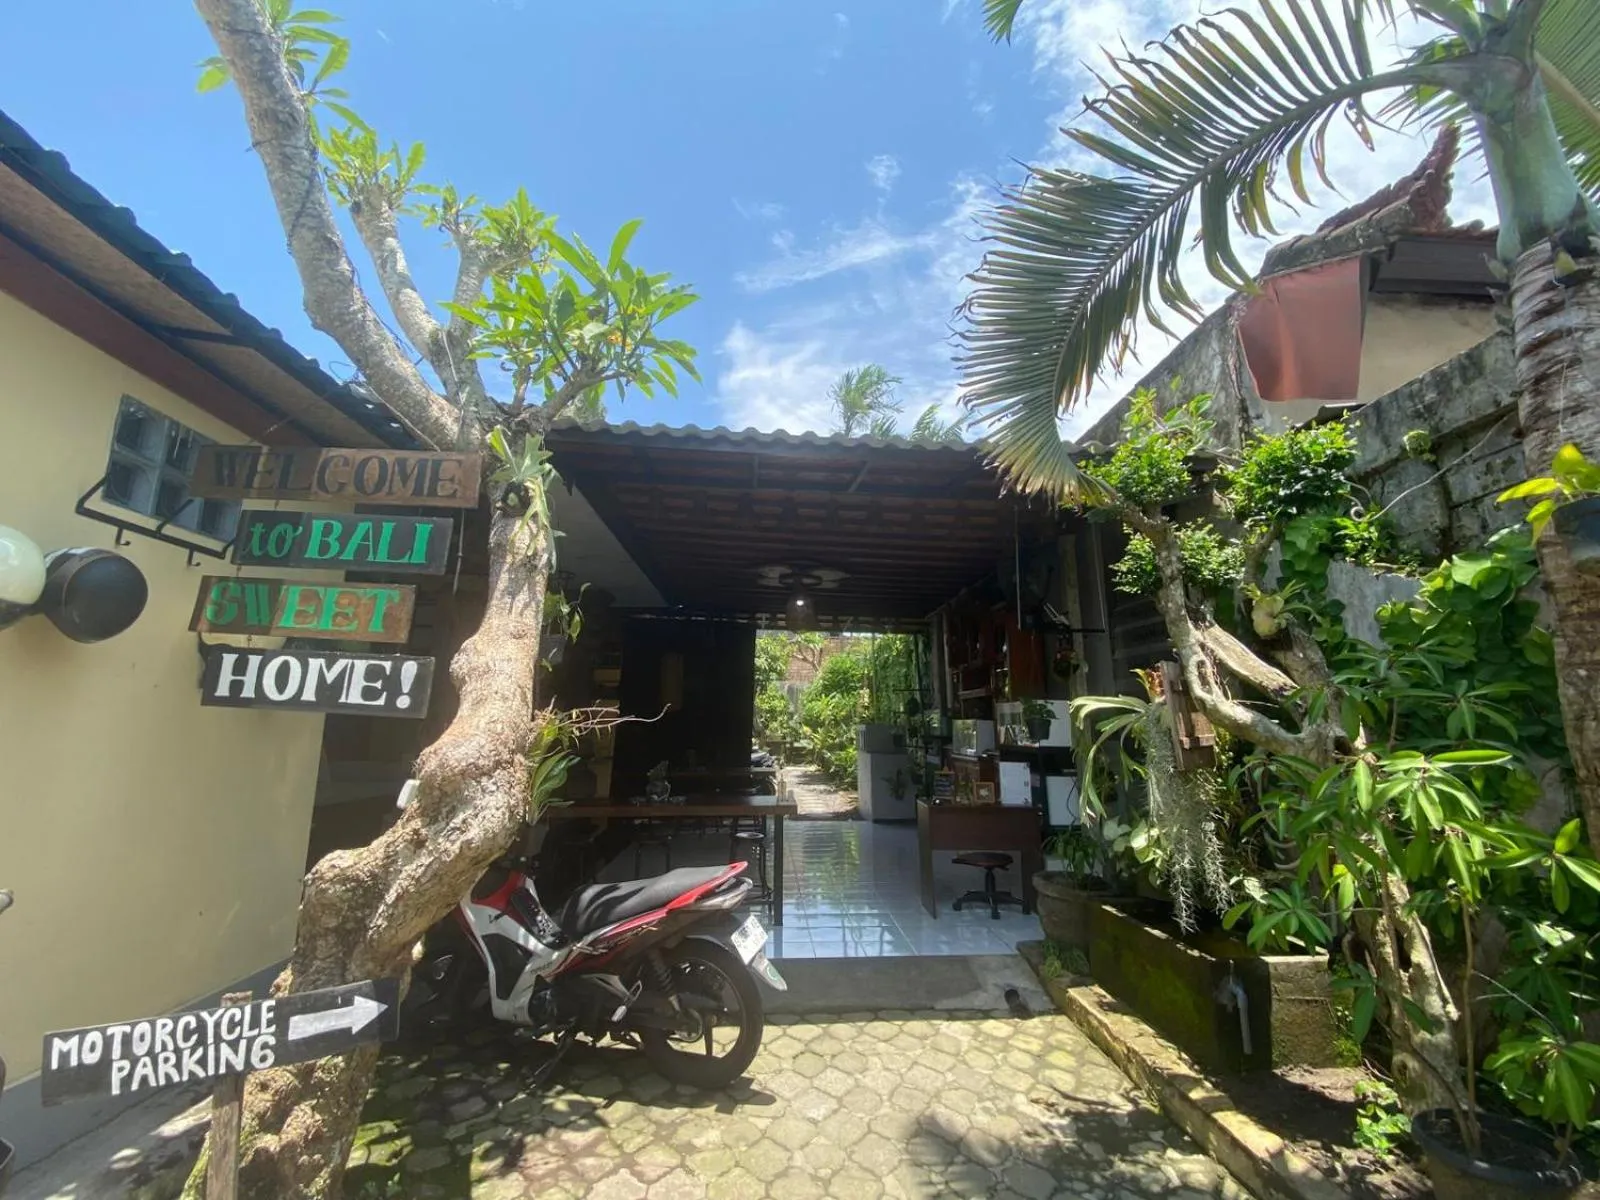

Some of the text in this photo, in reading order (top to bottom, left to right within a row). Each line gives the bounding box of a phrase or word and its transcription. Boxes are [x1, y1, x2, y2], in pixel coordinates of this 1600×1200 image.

[214, 451, 462, 498] WELCOME
[249, 519, 434, 564] to BALI
[205, 580, 399, 632] SWEET
[214, 653, 417, 709] HOME!
[51, 1000, 277, 1069] MOTORCYCLE
[111, 1035, 277, 1096] PARKING
